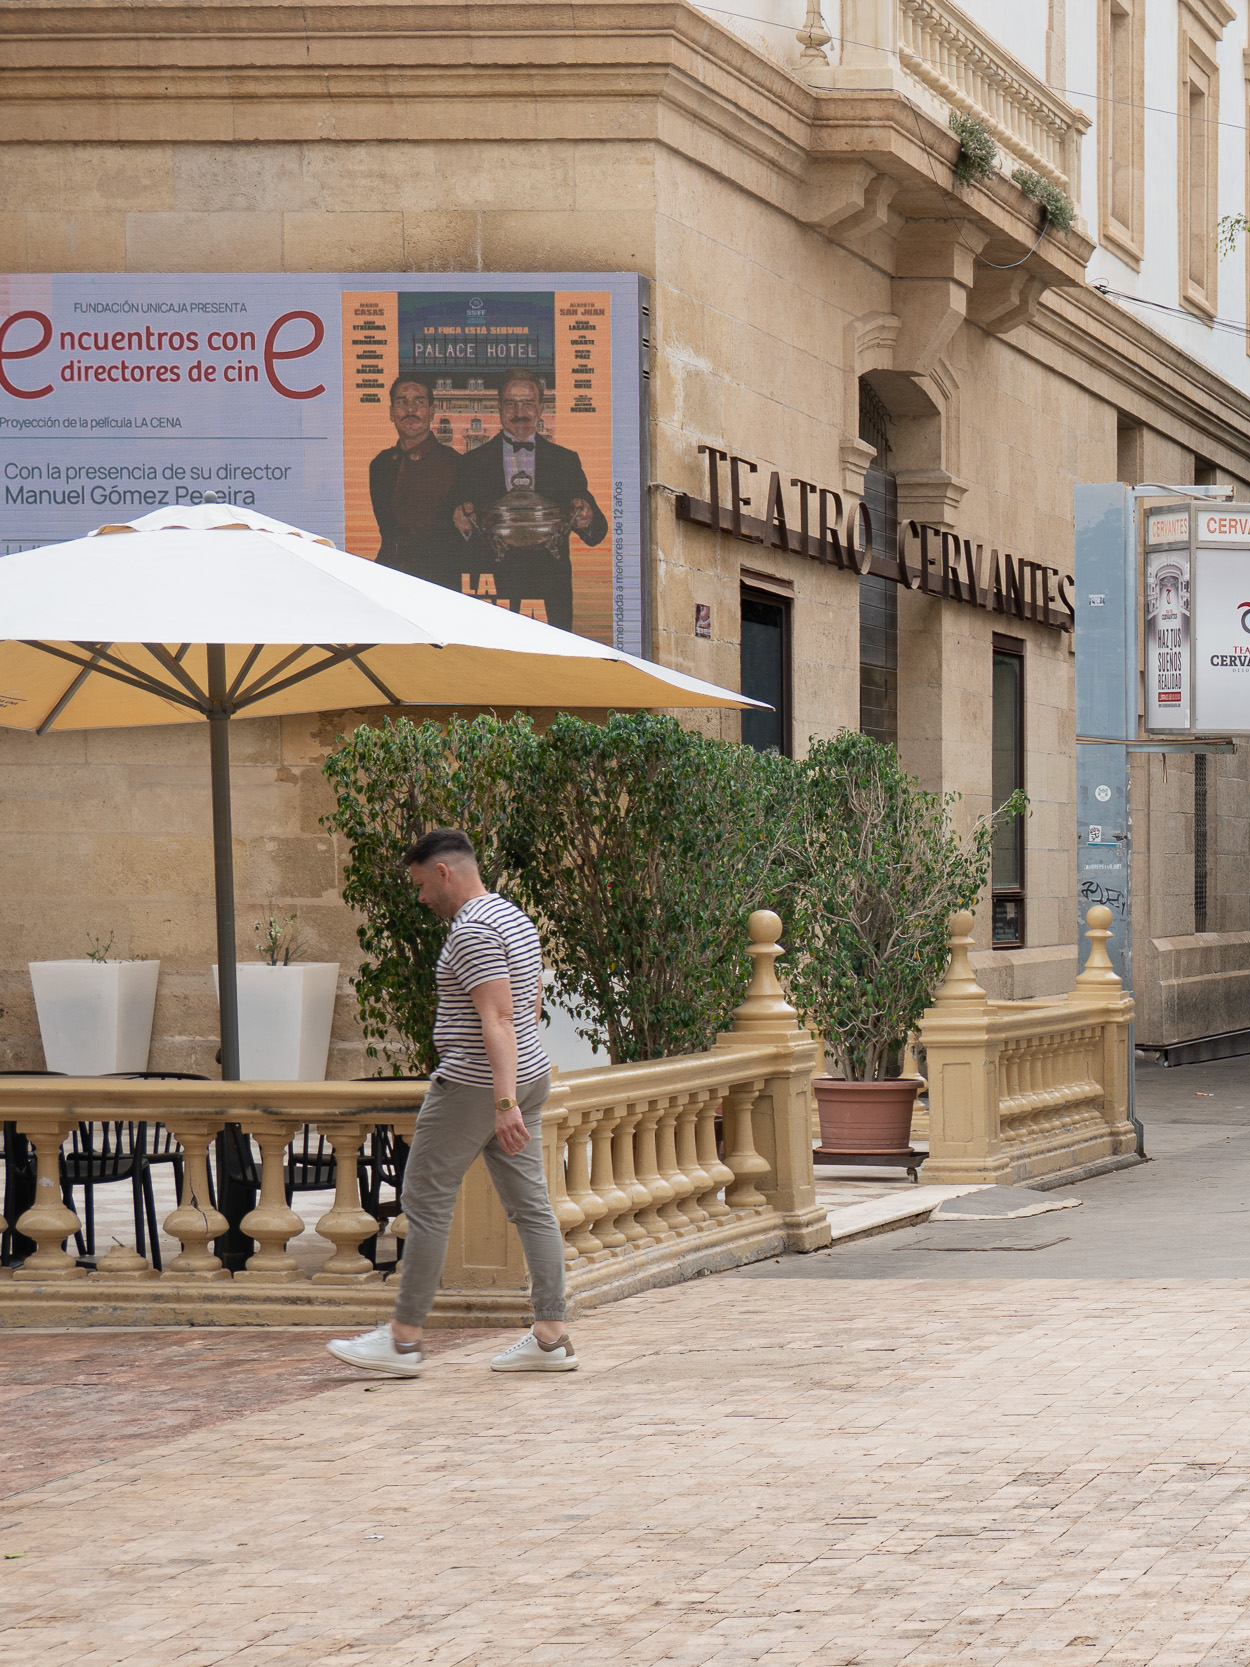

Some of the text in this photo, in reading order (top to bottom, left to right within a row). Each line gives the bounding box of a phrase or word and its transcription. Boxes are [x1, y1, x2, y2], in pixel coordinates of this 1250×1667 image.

[74, 300, 248, 313] FUNDACIÓN UNICAJA PRESENTA
[465, 326, 487, 334] ESTÁ
[207, 331, 256, 351] con
[415, 343, 537, 357] PALACE HOTEL
[60, 360, 181, 382] directores
[187, 360, 217, 382] de
[0, 417, 182, 430] Proyección de la película LA CENA
[4, 463, 291, 484] Con la presencia de su director
[5, 485, 85, 505] Manuel
[90, 484, 169, 505] Gómez
[613, 481, 623, 507] años
[613, 508, 623, 520] 12
[613, 521, 623, 536] de
[1152, 517, 1188, 538] CERVANTES
[698, 444, 1075, 633] TEATRO CERVANTES
[613, 537, 623, 584] menores
[461, 573, 497, 595] LA
[613, 594, 624, 653] omendada
[1158, 628, 1181, 648] HAZ TUS
[1158, 648, 1181, 672] SUEÑOS
[1158, 673, 1181, 690] REALIDAD
